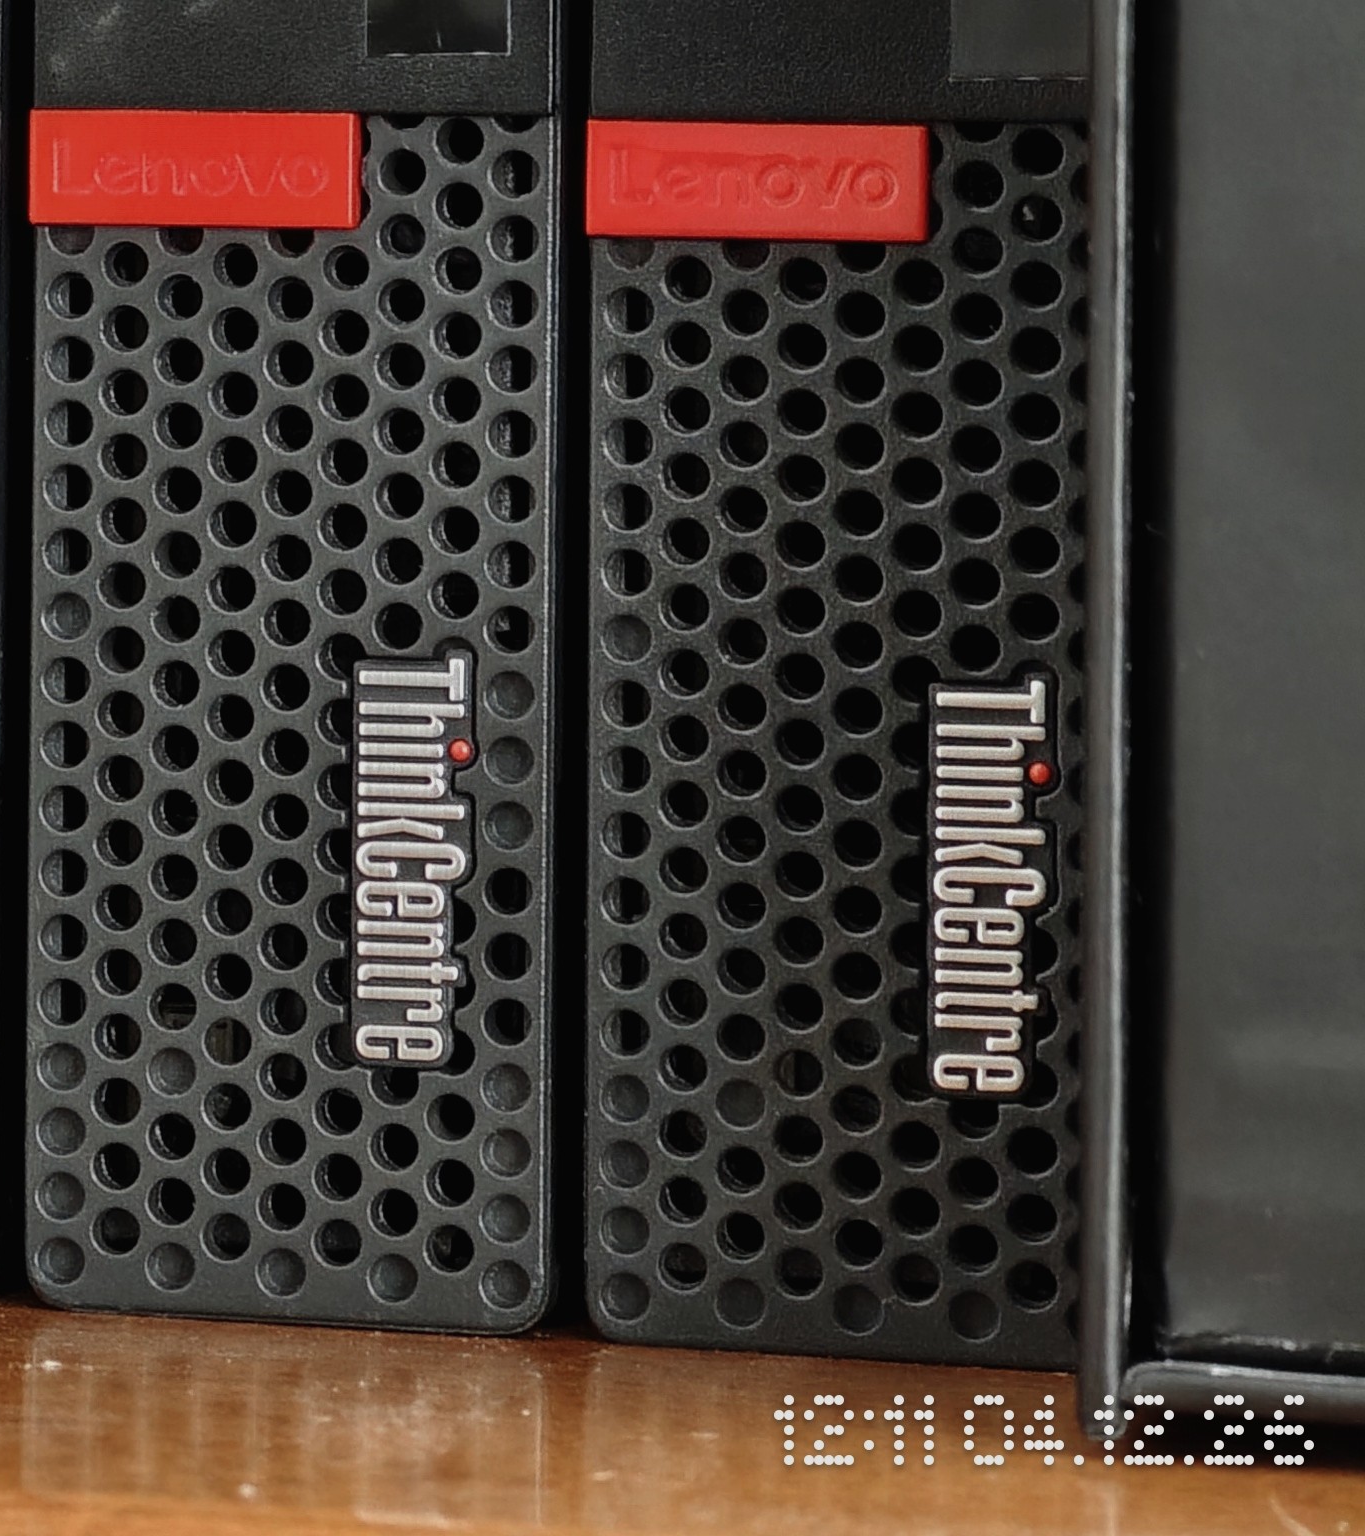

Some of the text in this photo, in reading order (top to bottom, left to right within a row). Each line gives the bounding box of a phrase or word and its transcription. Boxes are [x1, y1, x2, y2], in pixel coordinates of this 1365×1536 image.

[51, 139, 328, 198] Lenovo
[609, 146, 900, 211] Lenovo
[354, 658, 472, 1062] ThinkCentre
[933, 680, 1052, 1092] ThinkCentre
